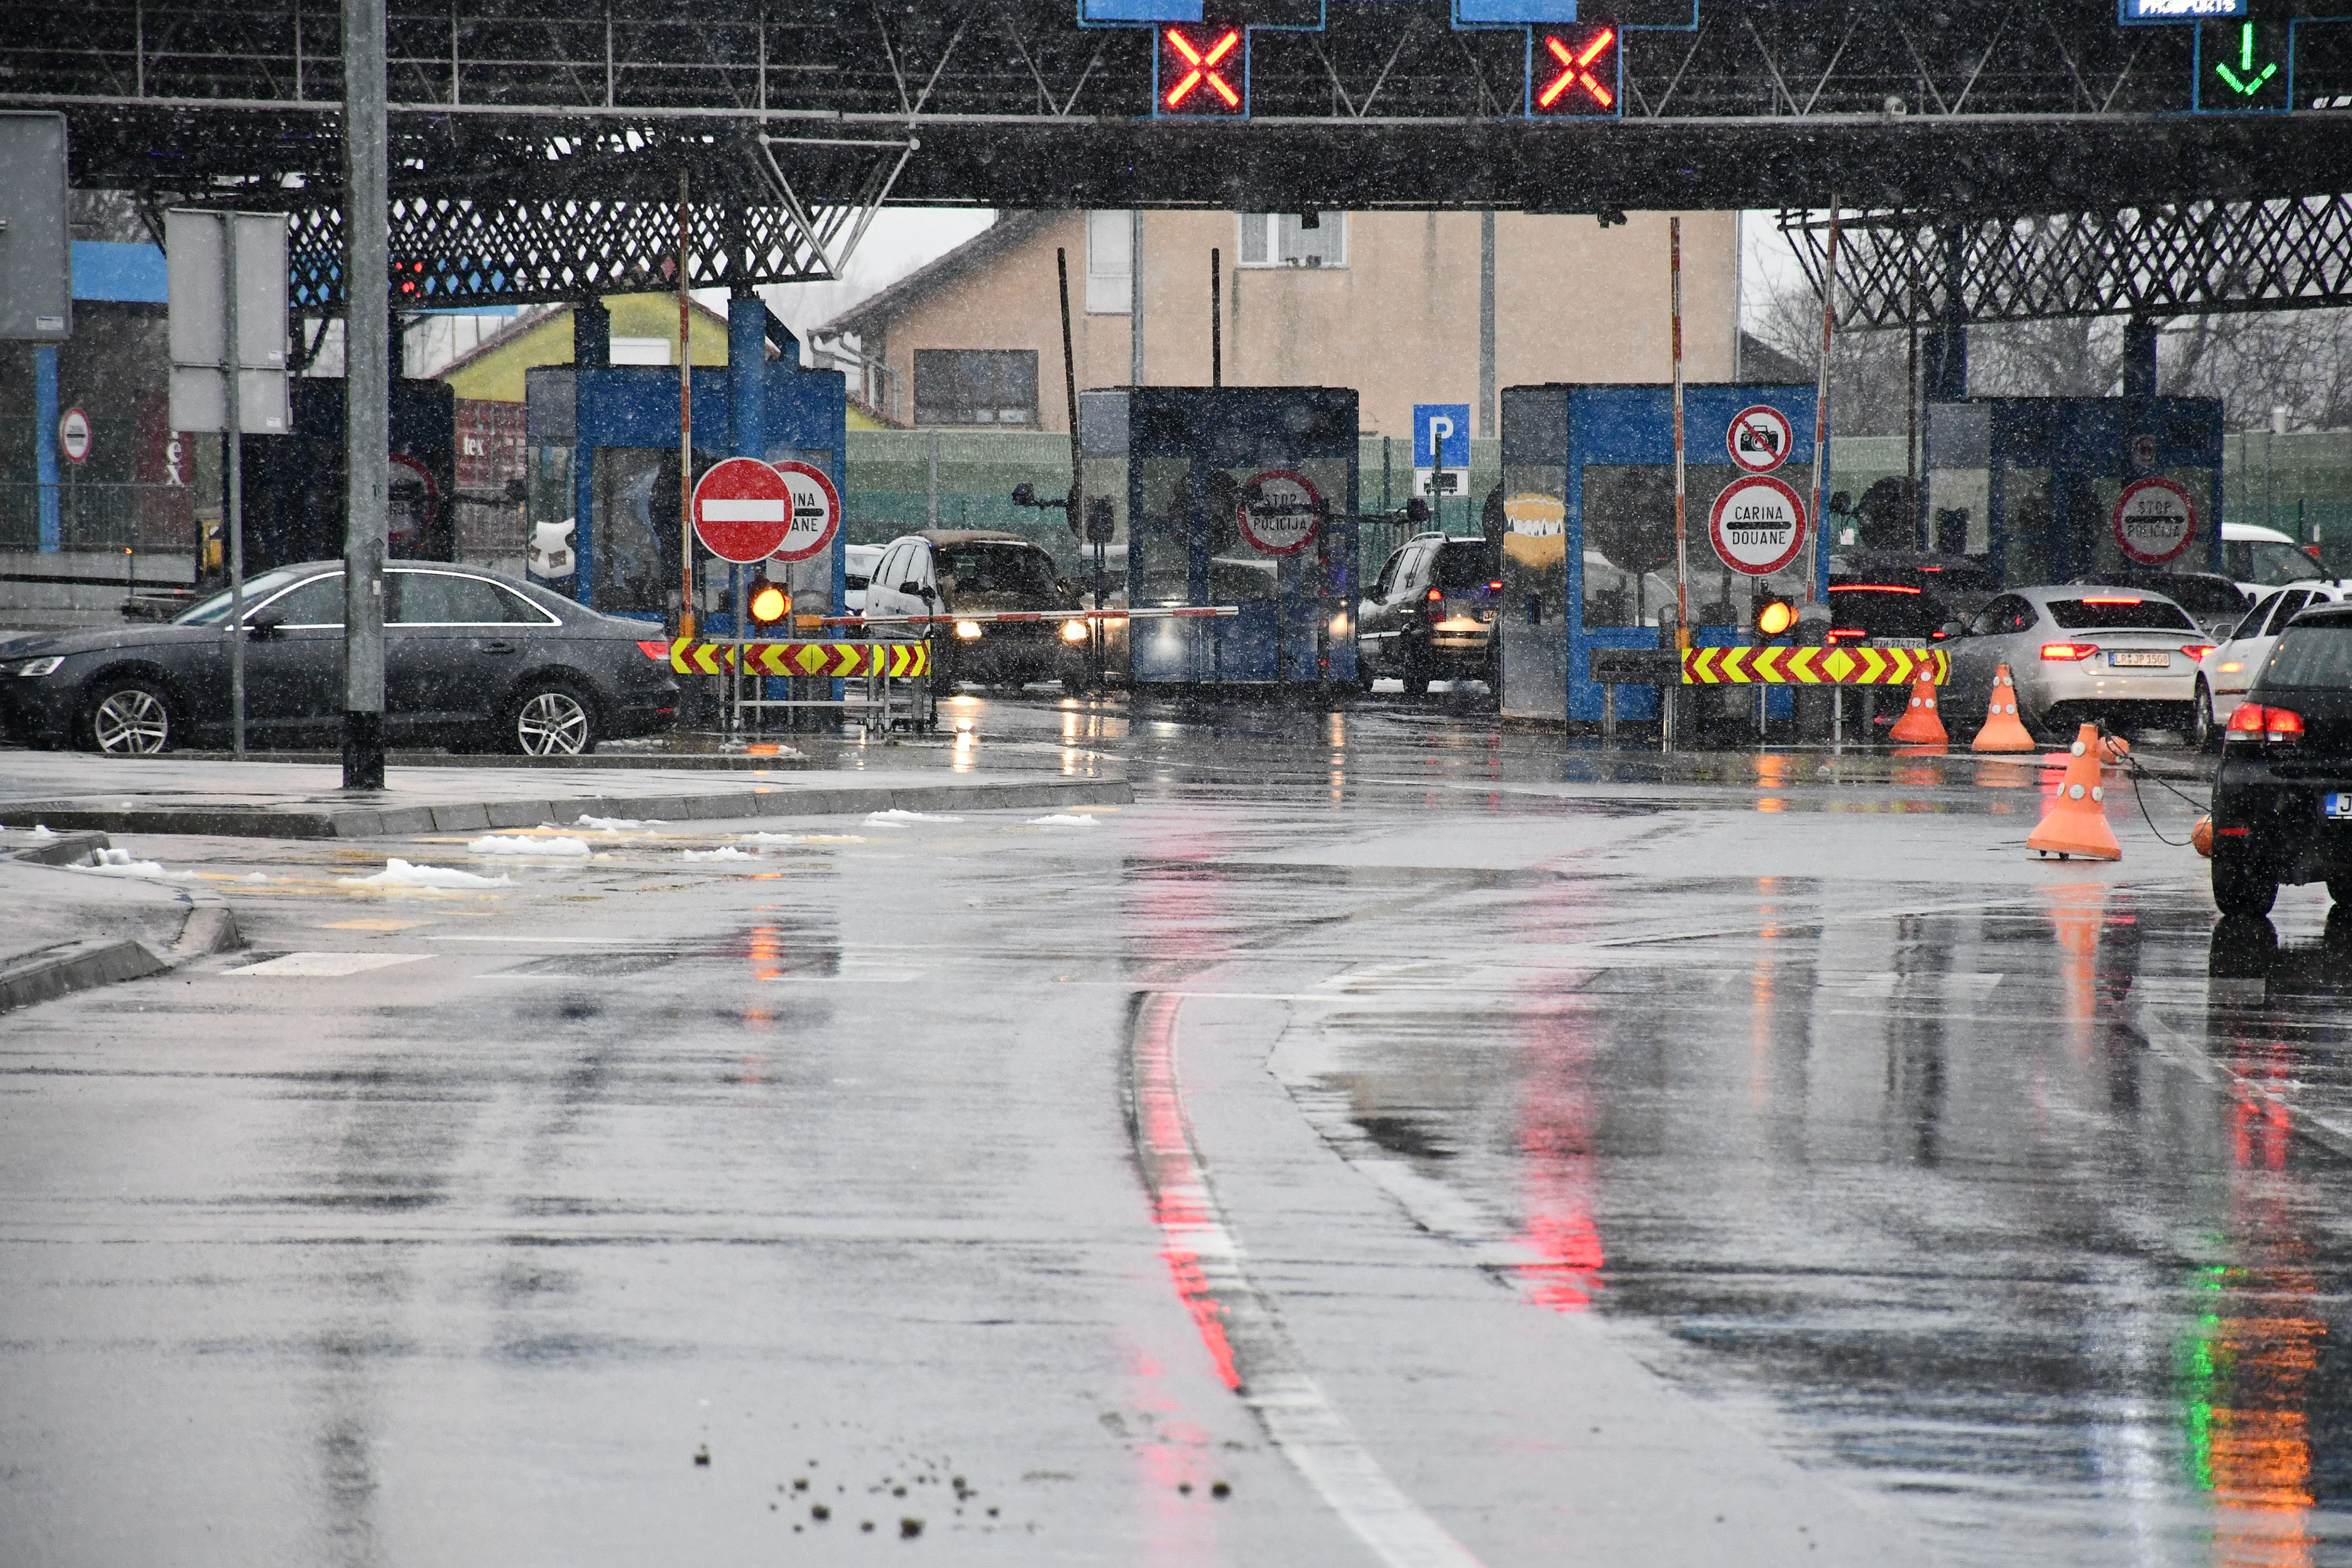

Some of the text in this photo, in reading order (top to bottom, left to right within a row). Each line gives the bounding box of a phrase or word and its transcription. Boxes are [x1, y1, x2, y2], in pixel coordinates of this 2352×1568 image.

[1430, 417, 1454, 455] P
[793, 493, 815, 506] INA
[1735, 506, 1783, 520] CARINA
[2139, 501, 2171, 514] STOP
[791, 518, 818, 531] ANE
[1254, 517, 1307, 530] POLICIJA
[1732, 531, 1786, 544] DOUANE
